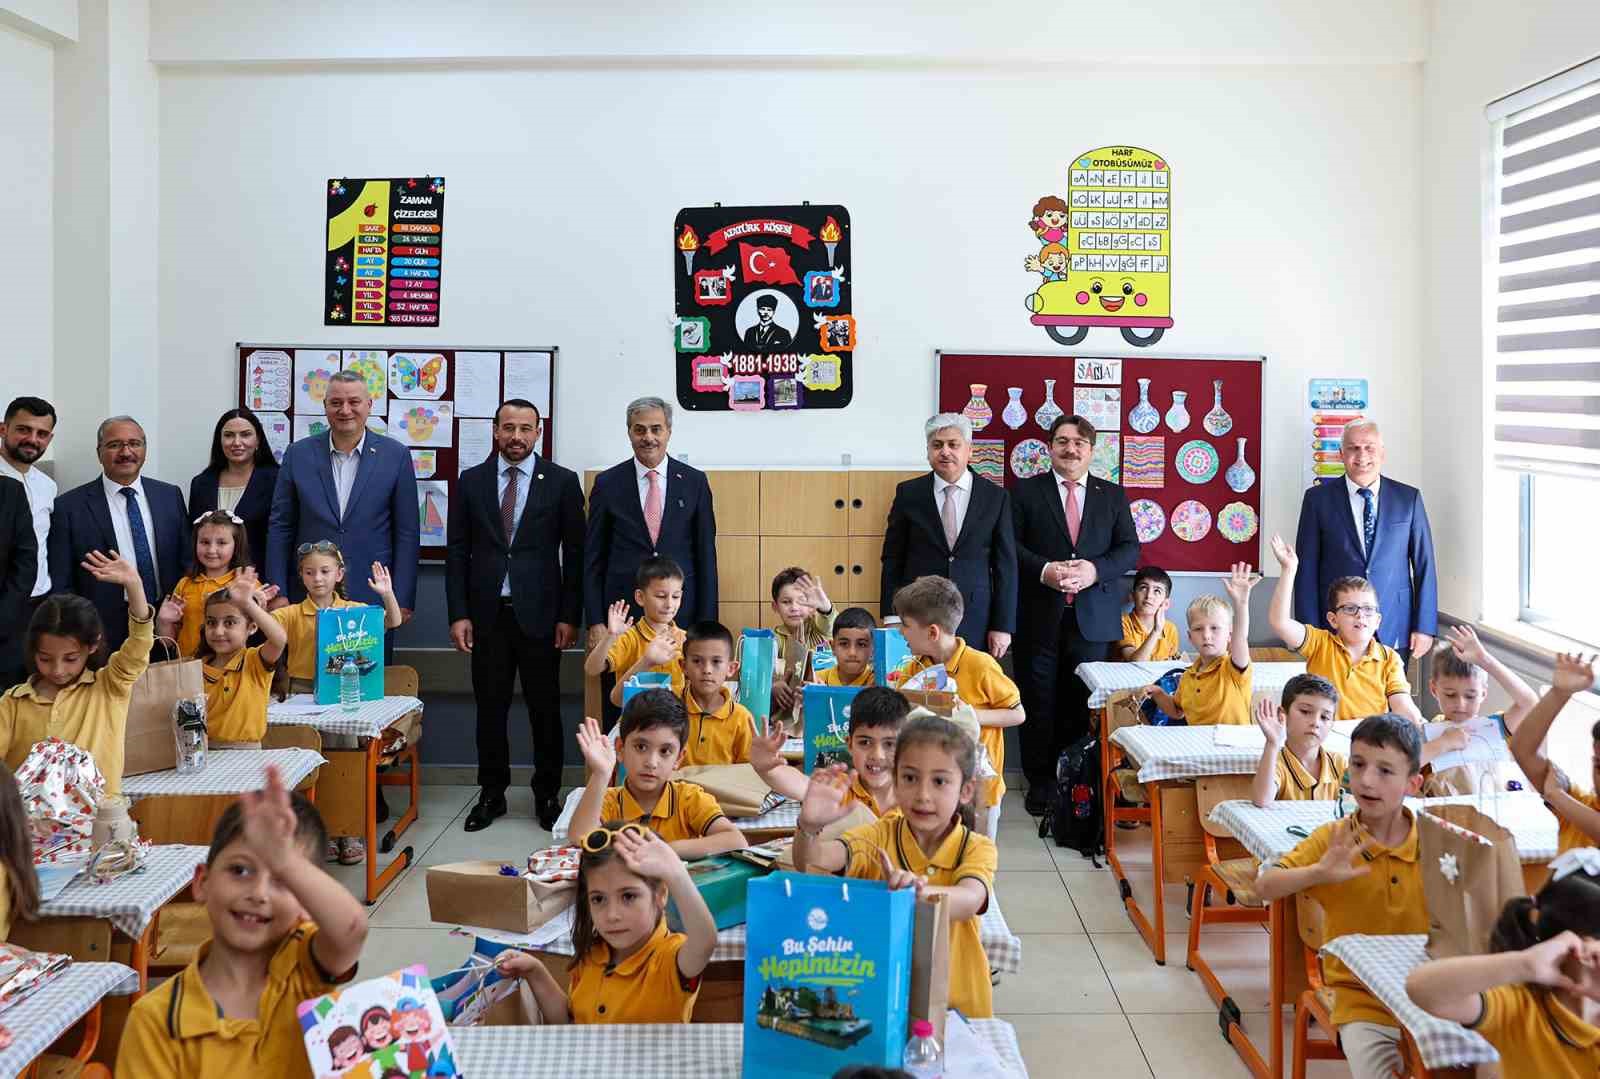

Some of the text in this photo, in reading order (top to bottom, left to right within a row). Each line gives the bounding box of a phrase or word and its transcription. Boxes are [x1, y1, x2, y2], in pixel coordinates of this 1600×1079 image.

[1092, 158, 1152, 168] OTOBÜSÜMÜZ
[400, 195, 432, 205] ZAMAN
[393, 209, 437, 220] ÇİZELGESİ
[732, 354, 798, 373] 1881-1938
[1077, 361, 1121, 381] SANAT
[782, 935, 853, 957] Bu Şehir
[758, 952, 876, 981] Hepimizin
